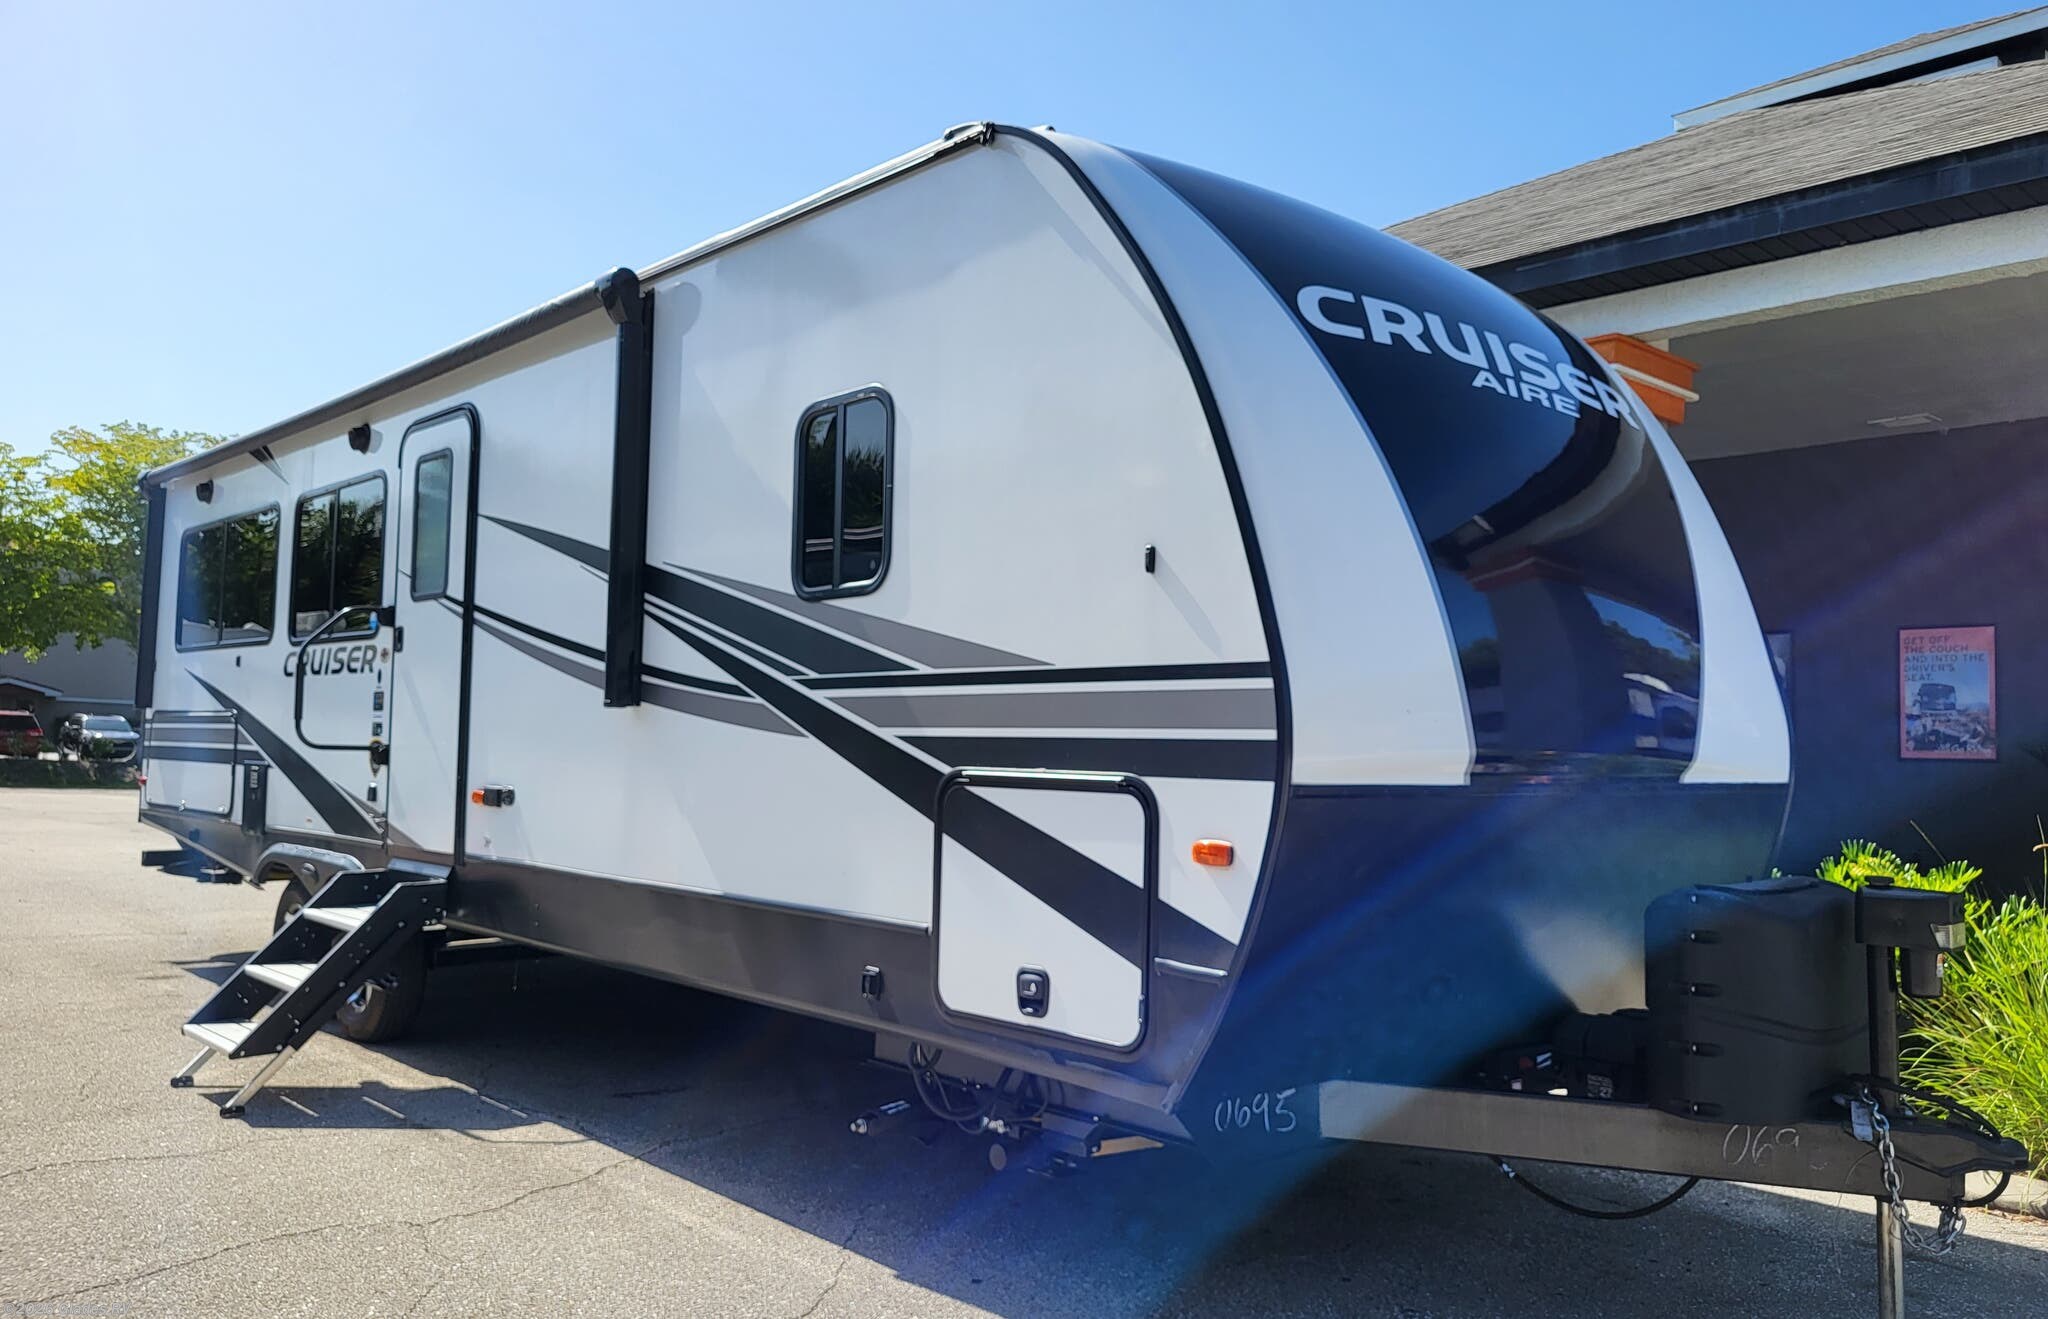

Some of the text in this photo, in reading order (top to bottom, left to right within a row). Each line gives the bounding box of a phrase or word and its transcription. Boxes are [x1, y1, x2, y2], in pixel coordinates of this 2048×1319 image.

[1296, 285, 1640, 430] CRUISER
[1471, 369, 1581, 418] AIRE
[1904, 635, 1951, 645] GET OFF
[1904, 644, 1968, 654] THE COUCH
[1904, 653, 1985, 663] AND INTO THE
[1904, 663, 1955, 672] DRIVER'S
[1214, 1088, 1296, 1132] 0695
[1722, 1124, 1829, 1170] 069
